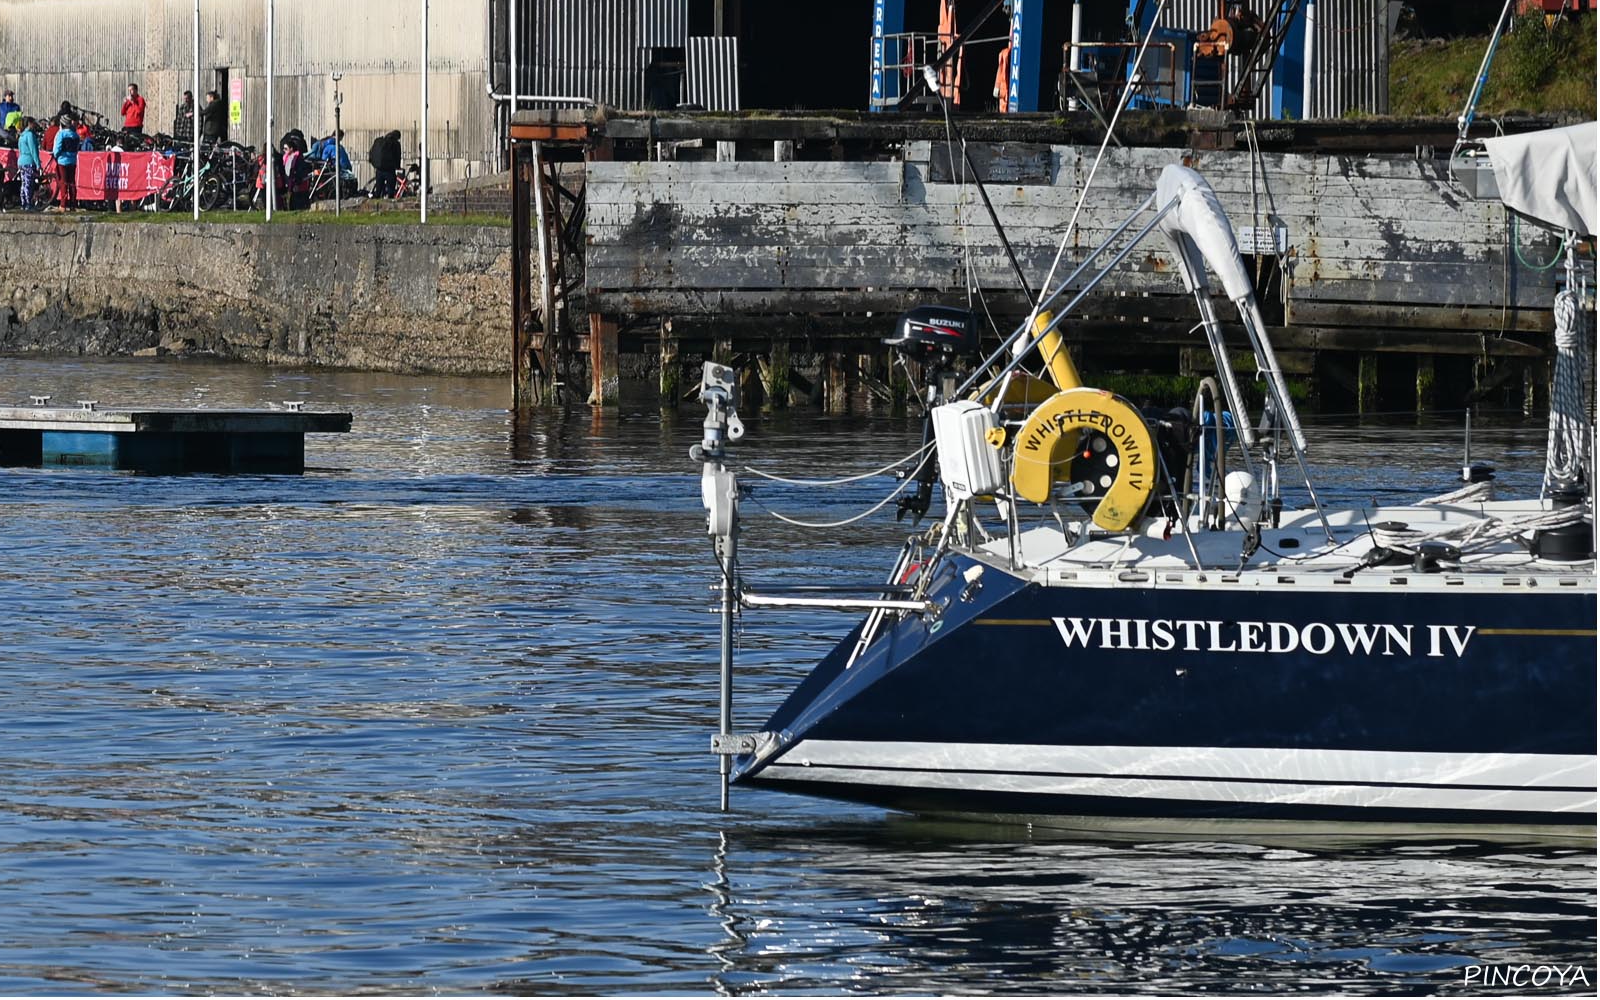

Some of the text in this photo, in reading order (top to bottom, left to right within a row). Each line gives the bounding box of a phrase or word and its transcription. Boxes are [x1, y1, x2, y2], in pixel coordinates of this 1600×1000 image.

[1010, 0, 1022, 97] MARINA
[105, 162, 129, 176] DURTY
[105, 177, 129, 189] EVENTS
[929, 318, 965, 329] SUZUKI
[1025, 408, 1143, 491] WHISTLEDOWN IV
[1051, 616, 1477, 658] WHISTLEDOWN IV
